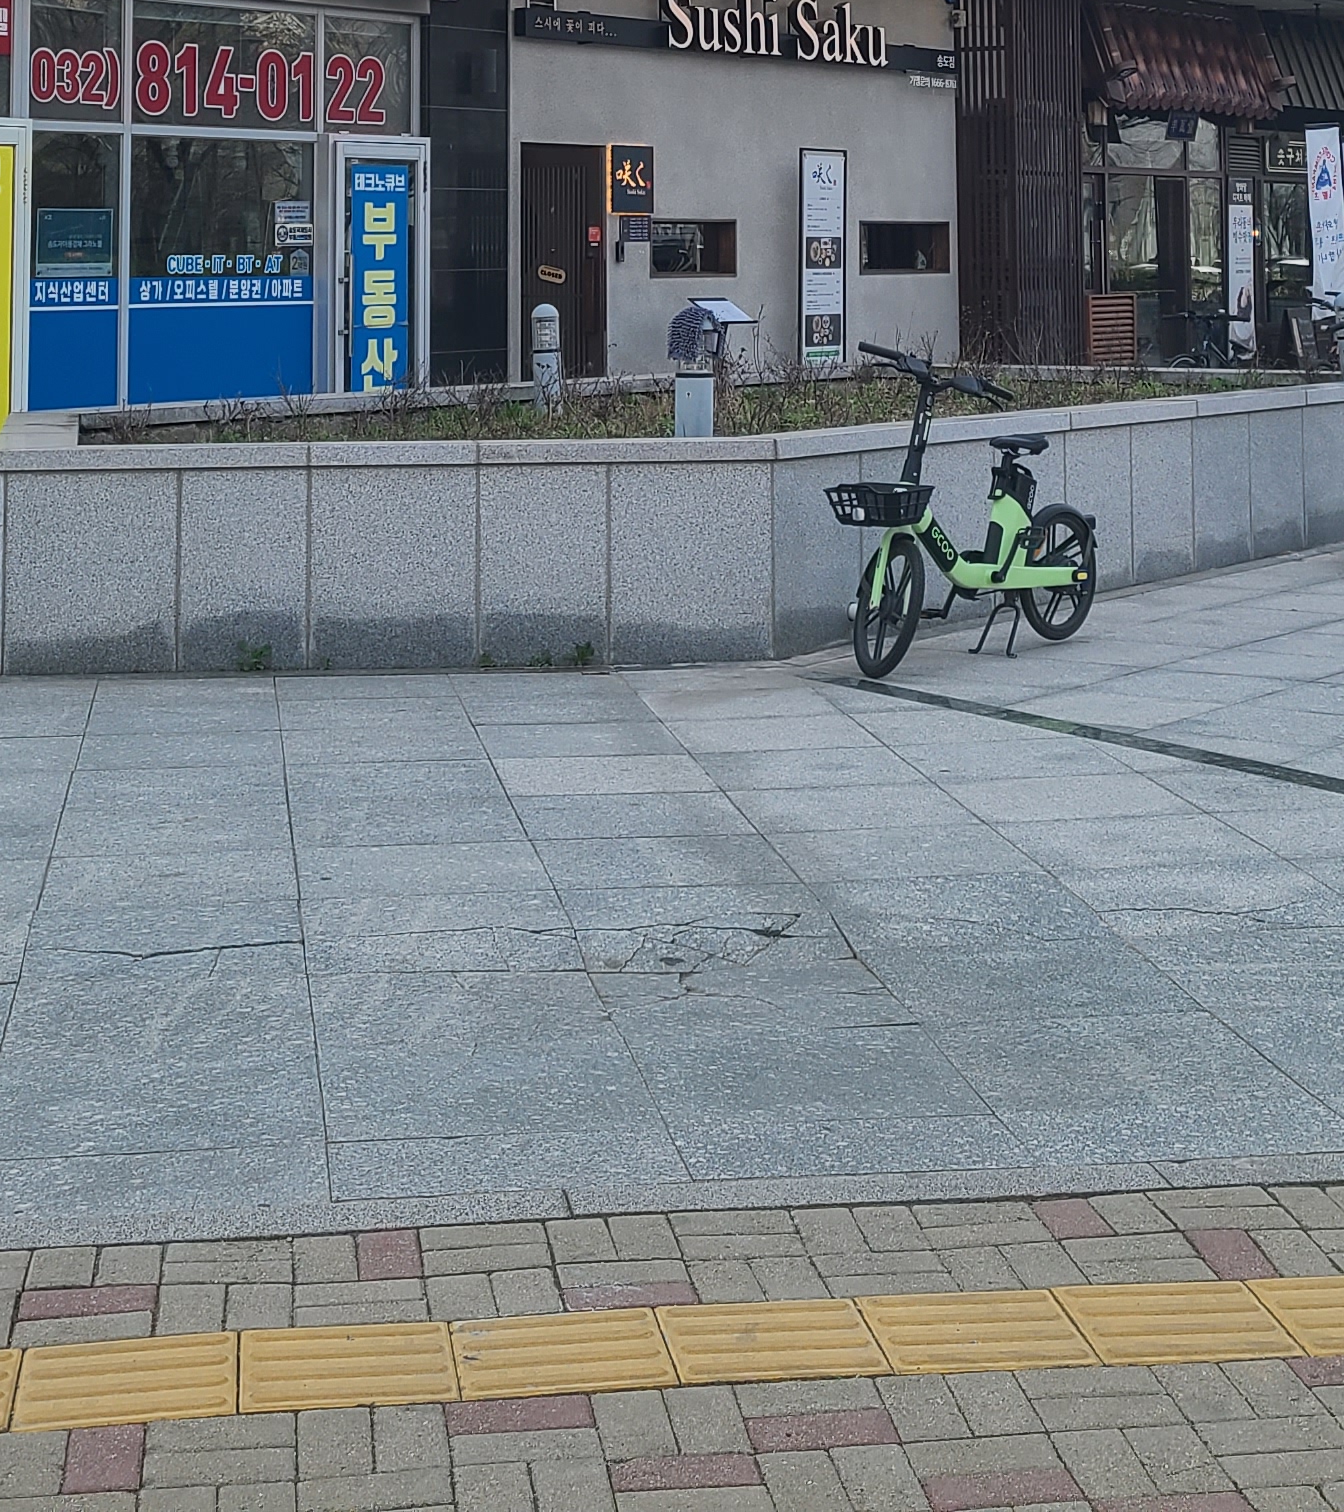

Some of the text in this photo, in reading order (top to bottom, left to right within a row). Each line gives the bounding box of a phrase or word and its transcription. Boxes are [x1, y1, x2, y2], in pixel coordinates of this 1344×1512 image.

[534, 16, 561, 31] 스시에
[566, 19, 583, 34] 꽃이
[136, 39, 386, 125] 814-0122
[354, 173, 406, 192] 테크노큐브
[540, 269, 563, 279] CLOSED
[34, 280, 109, 303] 지식산업센터
[1027, 484, 1035, 509] GCOO
[931, 526, 955, 561] GCOO
